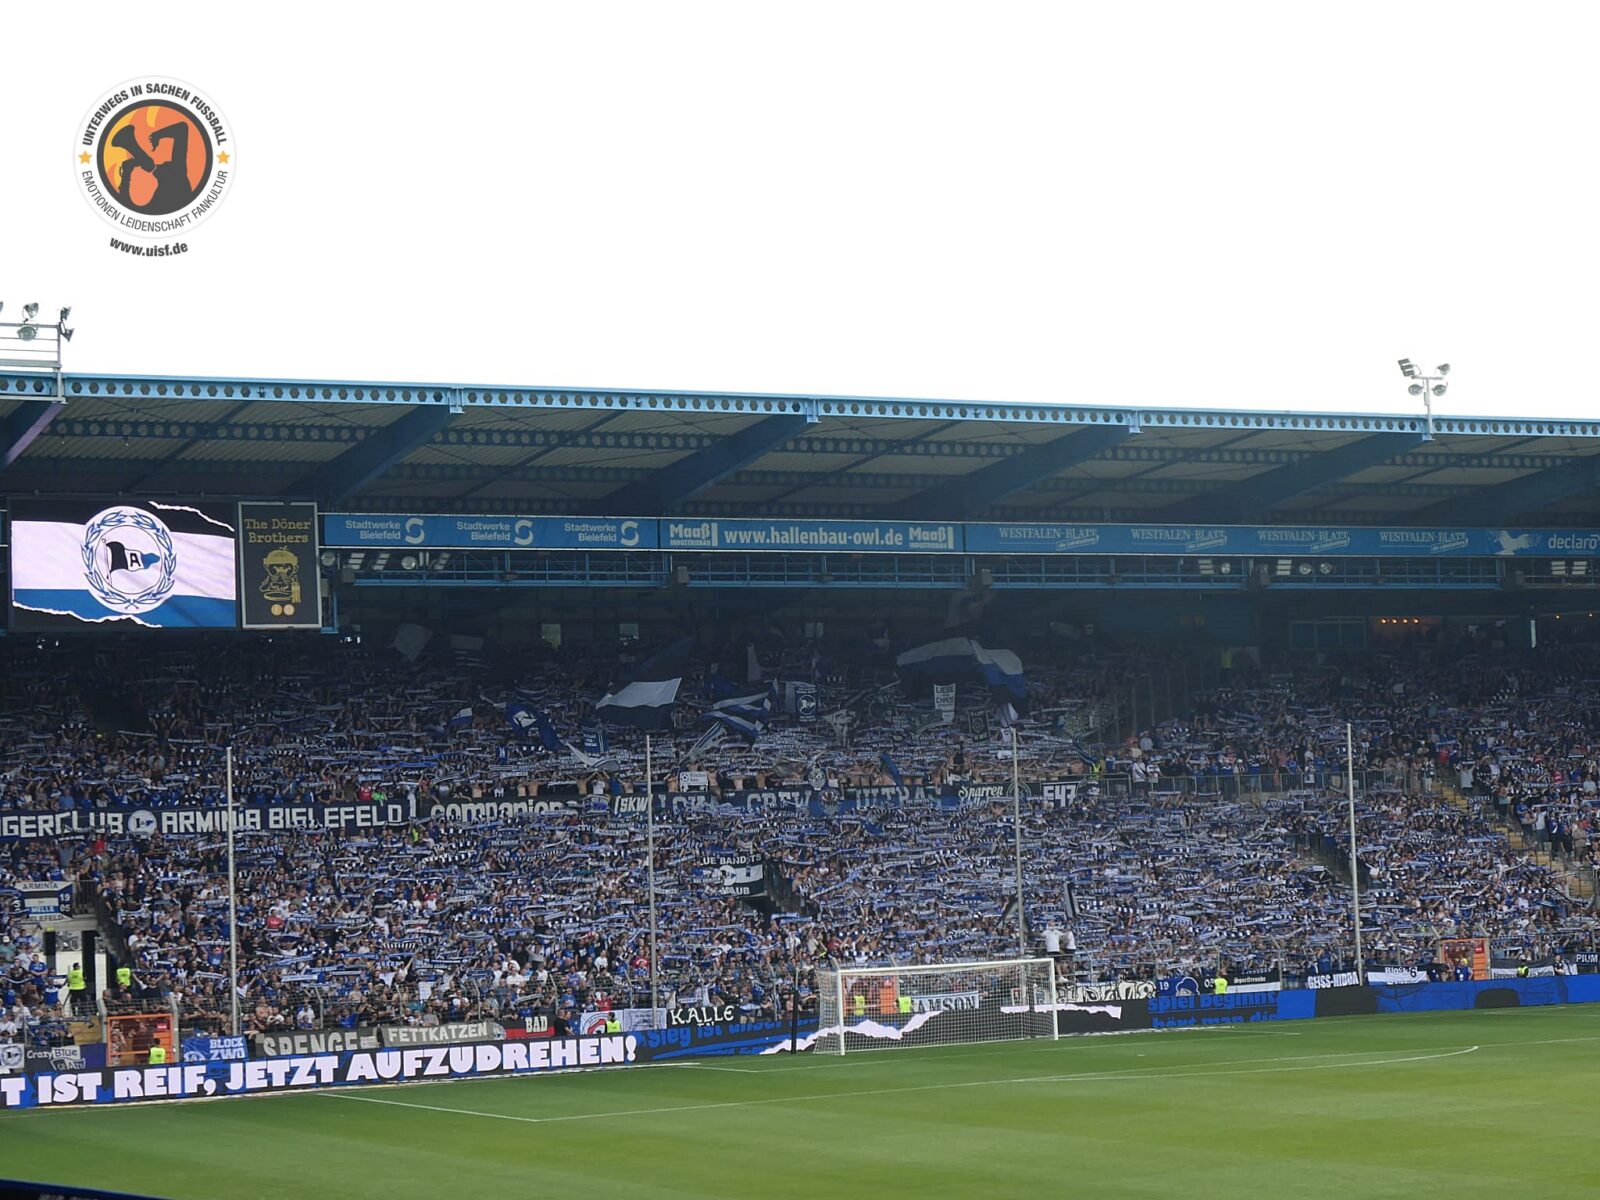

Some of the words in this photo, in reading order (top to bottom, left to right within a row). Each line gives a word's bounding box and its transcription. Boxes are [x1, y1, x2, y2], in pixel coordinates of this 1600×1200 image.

[244, 518, 268, 530] The
[271, 518, 312, 530] Döner
[345, 519, 401, 530] Stadtwerke
[456, 521, 511, 532] Stadtwerke
[564, 522, 617, 533] Stadtwerke
[248, 532, 309, 543] Brothers
[360, 530, 401, 540] Bielefeld
[470, 531, 511, 541] Bielefeld
[577, 532, 617, 543] Bielefeld
[669, 523, 711, 540] Maaß
[724, 526, 903, 547] www.hallenbau-owl.de
[430, 799, 577, 824] companion
[161, 809, 260, 834] ARMINIA
[268, 804, 402, 829] BIELEFELD
[719, 854, 762, 866] BANDTS
[23, 882, 59, 890] ARMINIA
[59, 893, 71, 902] 19
[59, 904, 71, 912] 05
[1409, 966, 1418, 978] 6
[1159, 980, 1169, 990] 19
[909, 996, 977, 1013] AMSON
[670, 1005, 735, 1026] KALLE
[525, 1016, 548, 1033] BAD
[388, 1021, 488, 1043] FETTKATZEN
[209, 1037, 244, 1049] BLOCK
[26, 1050, 53, 1061] Crazy
[54, 1047, 78, 1057] Blue
[209, 1047, 246, 1061] ZWO
[1, 1078, 26, 1106] T
[38, 1072, 103, 1104] IST
[114, 1065, 217, 1098] REIF,
[225, 1055, 339, 1090] JETZT
[346, 1035, 637, 1082] AUFZUDREHEN!
